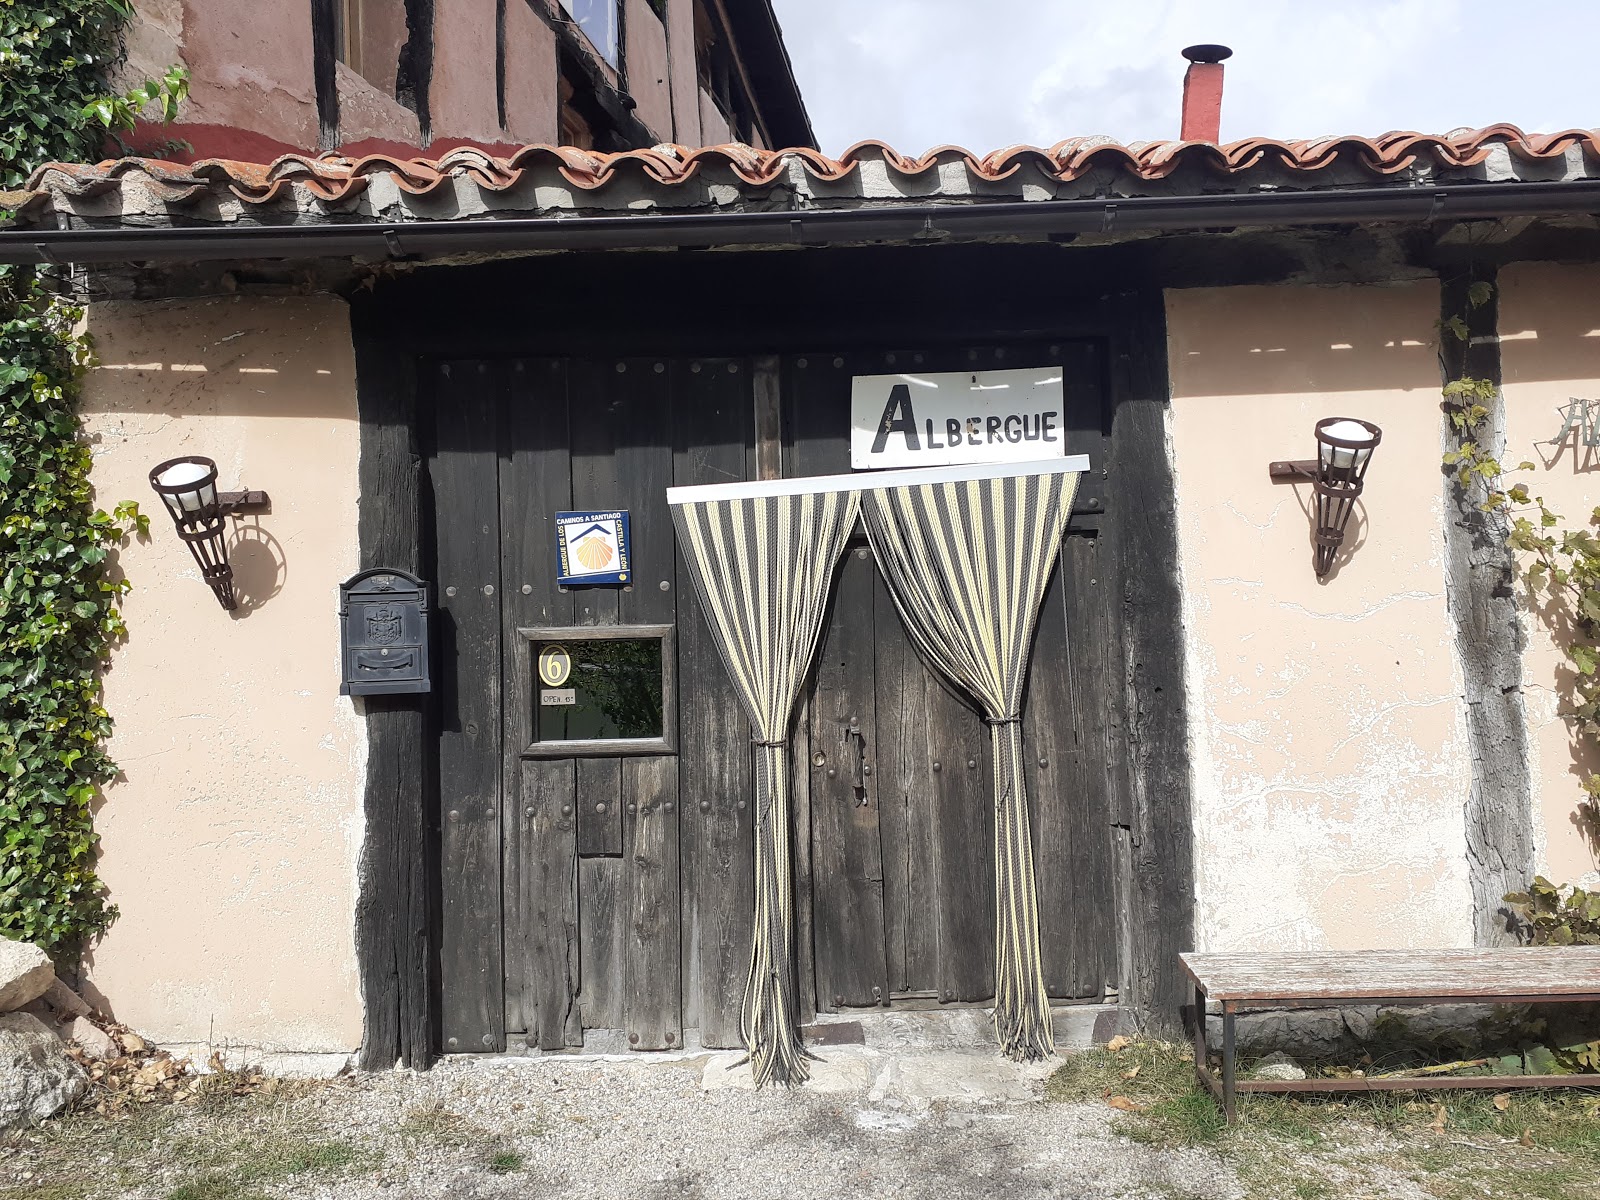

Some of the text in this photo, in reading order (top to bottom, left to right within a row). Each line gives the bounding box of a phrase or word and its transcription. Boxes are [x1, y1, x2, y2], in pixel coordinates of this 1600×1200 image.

[871, 384, 1058, 453] ALBERGUE
[557, 517, 584, 525] CAMINOS
[591, 513, 621, 521] SANTIAGO
[559, 537, 565, 546] DE
[616, 520, 624, 547] CASTILLA
[560, 546, 569, 577] ALBERGUE
[547, 651, 561, 679] 6
